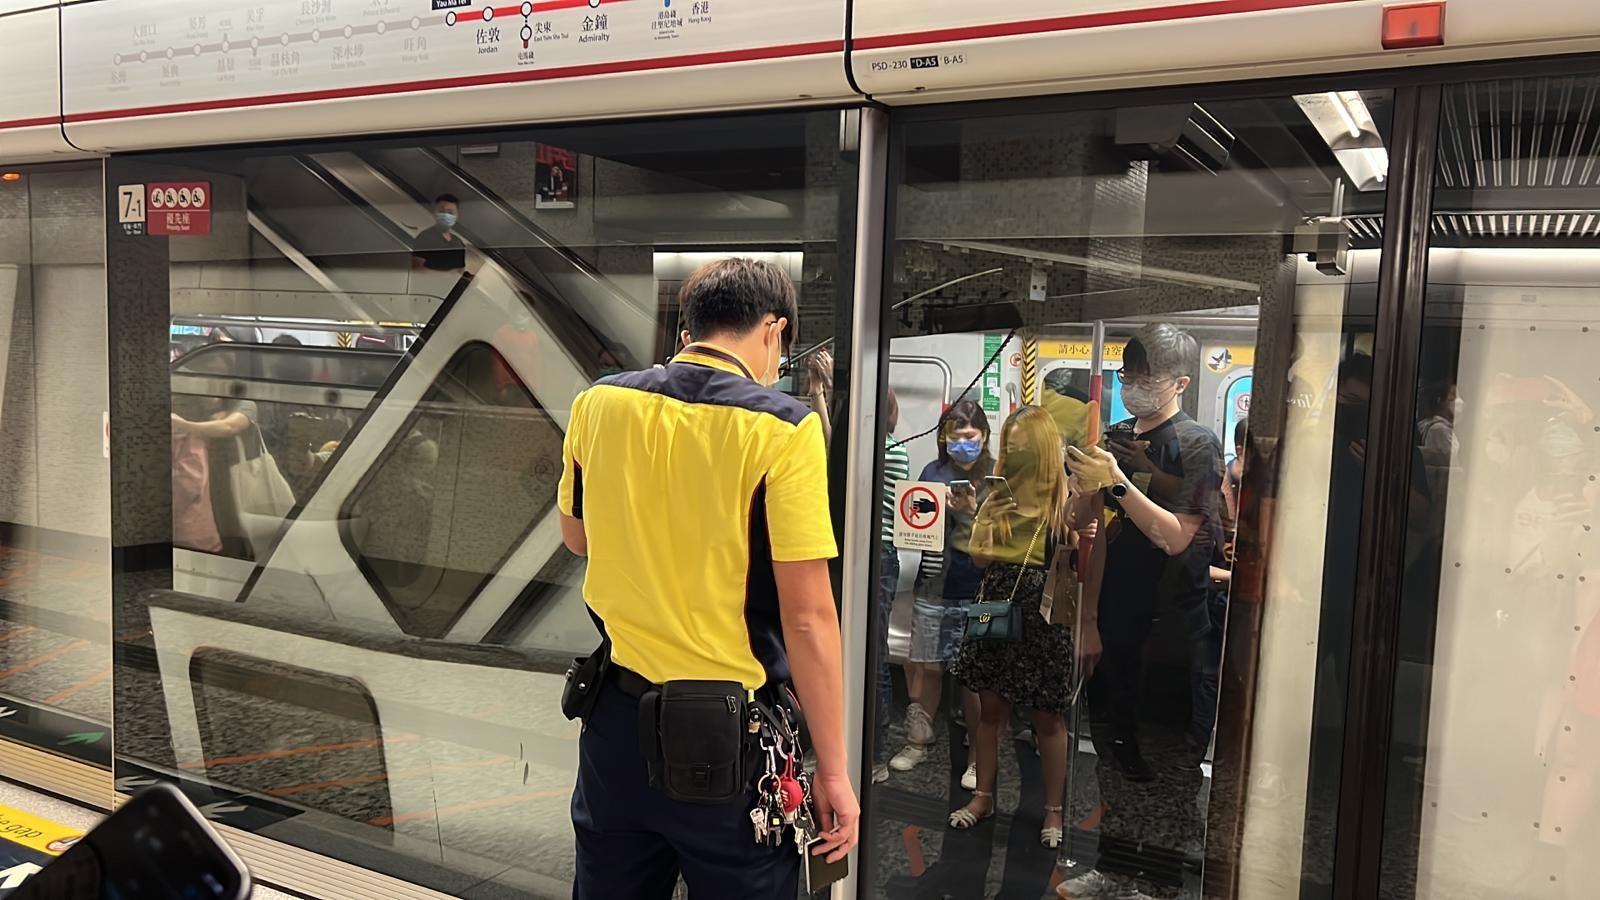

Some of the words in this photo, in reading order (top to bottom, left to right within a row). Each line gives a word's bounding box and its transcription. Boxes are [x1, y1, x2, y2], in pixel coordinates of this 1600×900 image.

[692, 0, 709, 15] 香港
[535, 21, 552, 34] 尖東
[582, 13, 608, 32] 金鐘
[476, 27, 500, 45] 佐敦
[578, 33, 610, 43] Admiralty
[478, 46, 498, 54] Jordan
